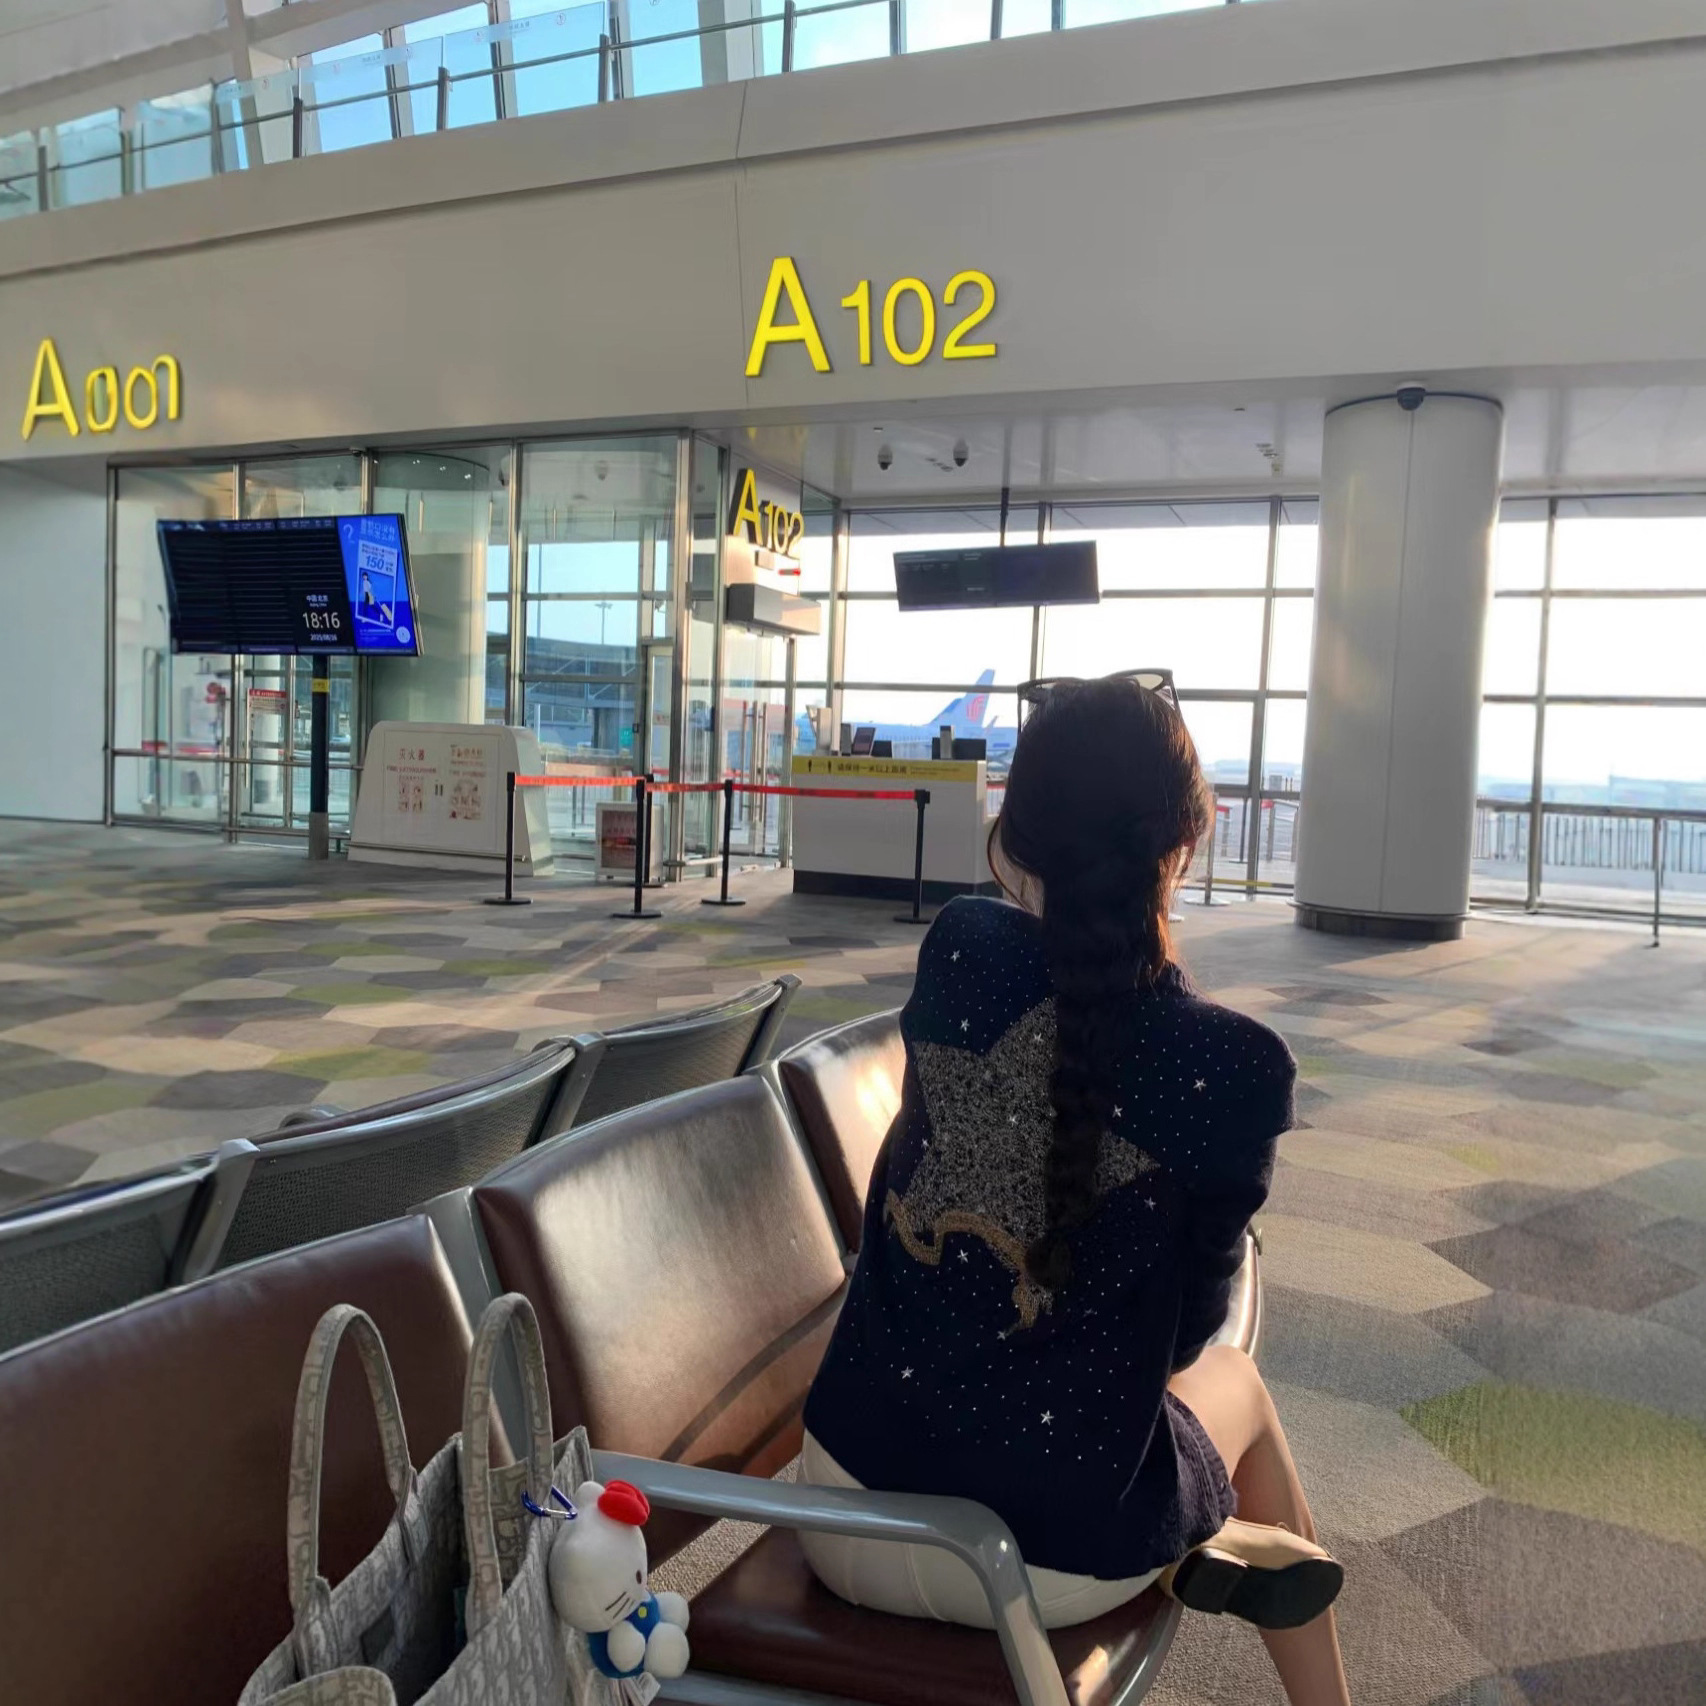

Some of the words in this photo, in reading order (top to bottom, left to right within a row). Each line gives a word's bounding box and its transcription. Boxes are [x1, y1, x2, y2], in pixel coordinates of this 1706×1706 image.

[745, 256, 997, 376] A102
[730, 468, 805, 559] A102
[366, 555, 385, 570] 150
[302, 612, 340, 629] 18:16
